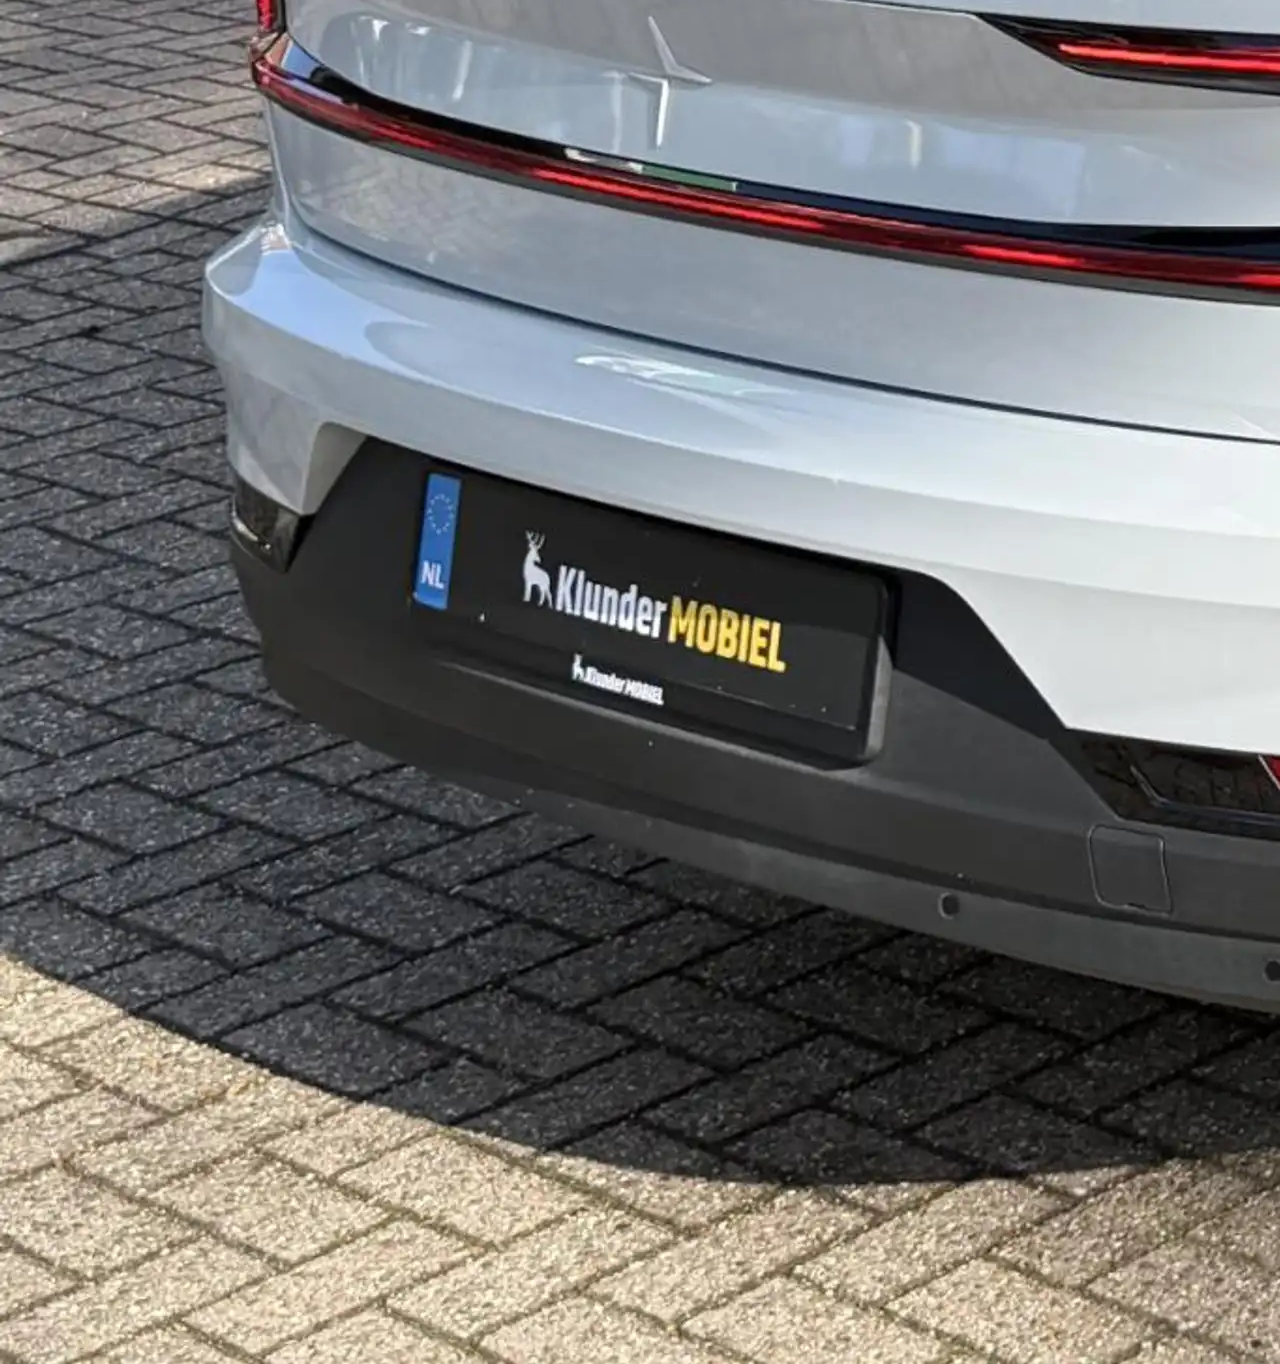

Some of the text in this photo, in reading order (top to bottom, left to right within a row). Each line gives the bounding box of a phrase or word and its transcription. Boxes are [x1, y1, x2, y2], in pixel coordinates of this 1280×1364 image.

[420, 561, 445, 590] NL
[555, 564, 787, 674] Klunder MOBIEL
